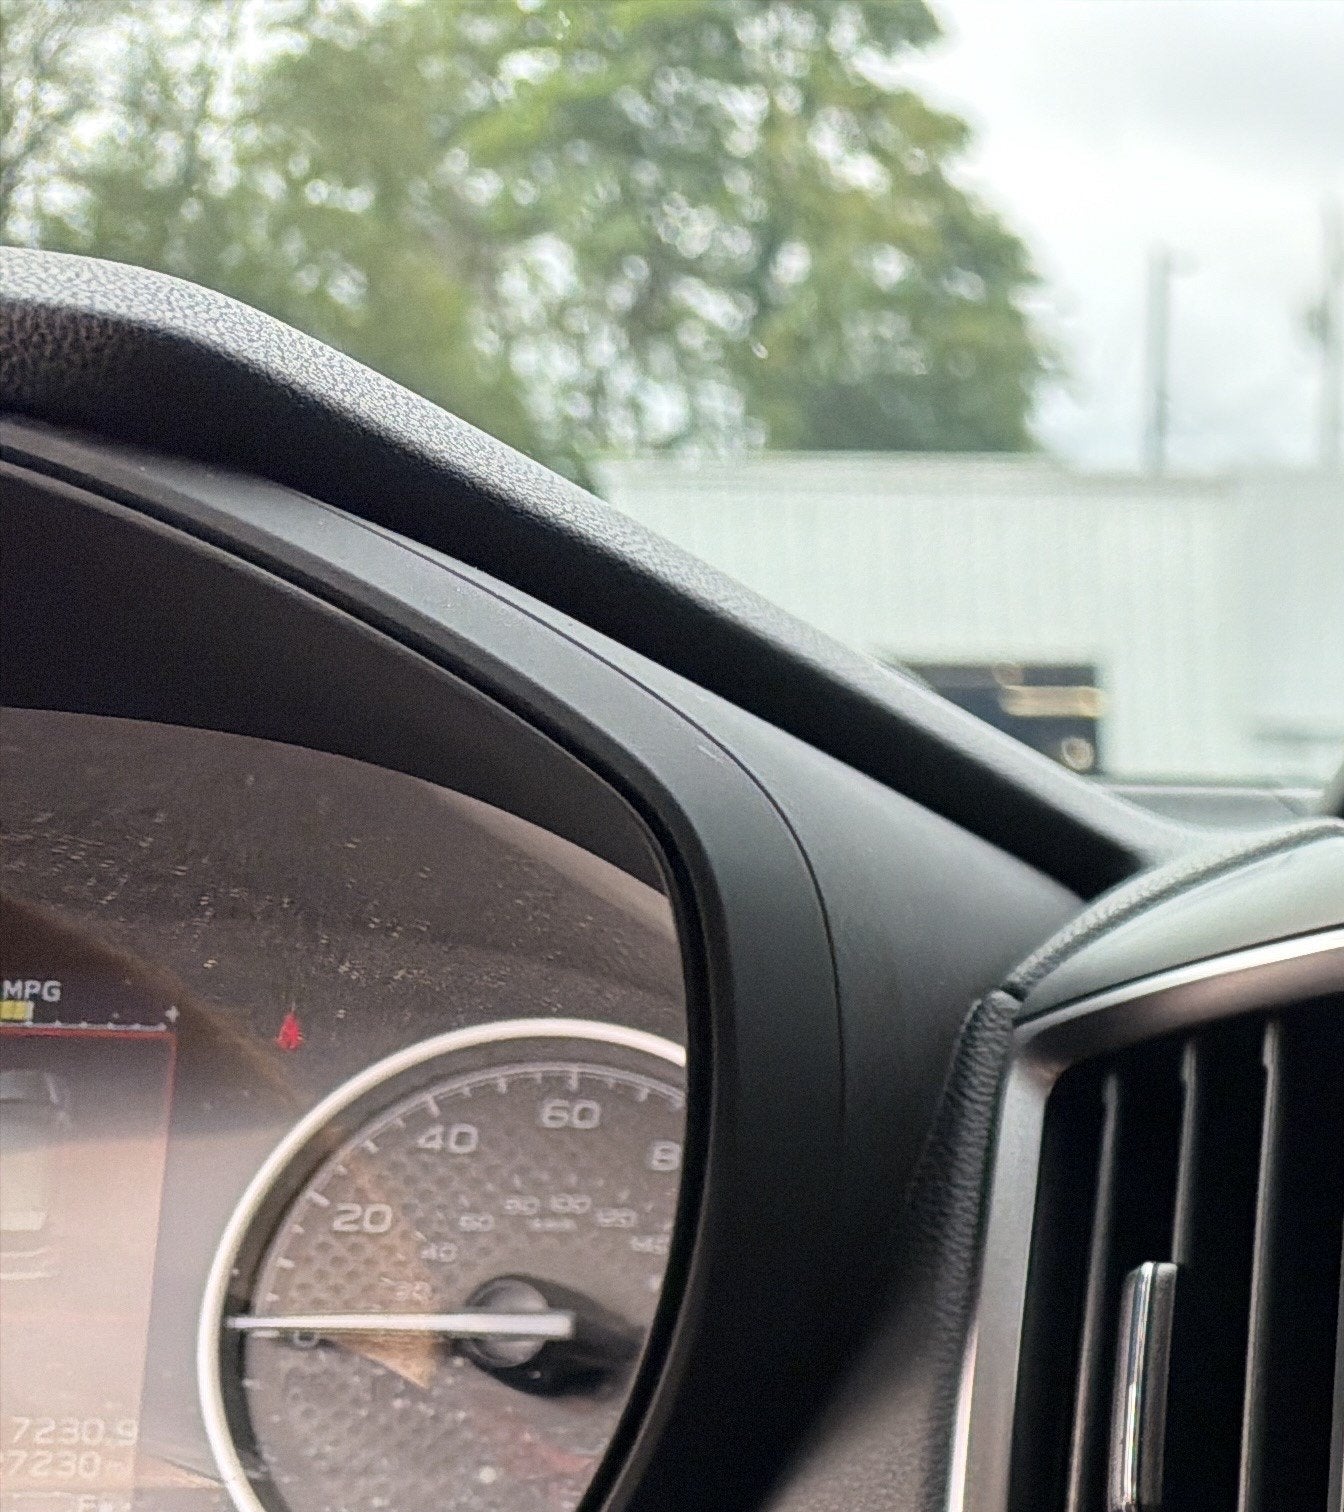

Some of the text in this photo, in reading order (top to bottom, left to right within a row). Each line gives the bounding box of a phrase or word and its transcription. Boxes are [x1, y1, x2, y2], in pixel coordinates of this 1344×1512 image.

[3, 980, 61, 1002] MPG
[541, 1099, 600, 1128] 60
[417, 1123, 478, 1153] 40
[333, 1202, 392, 1233] 20
